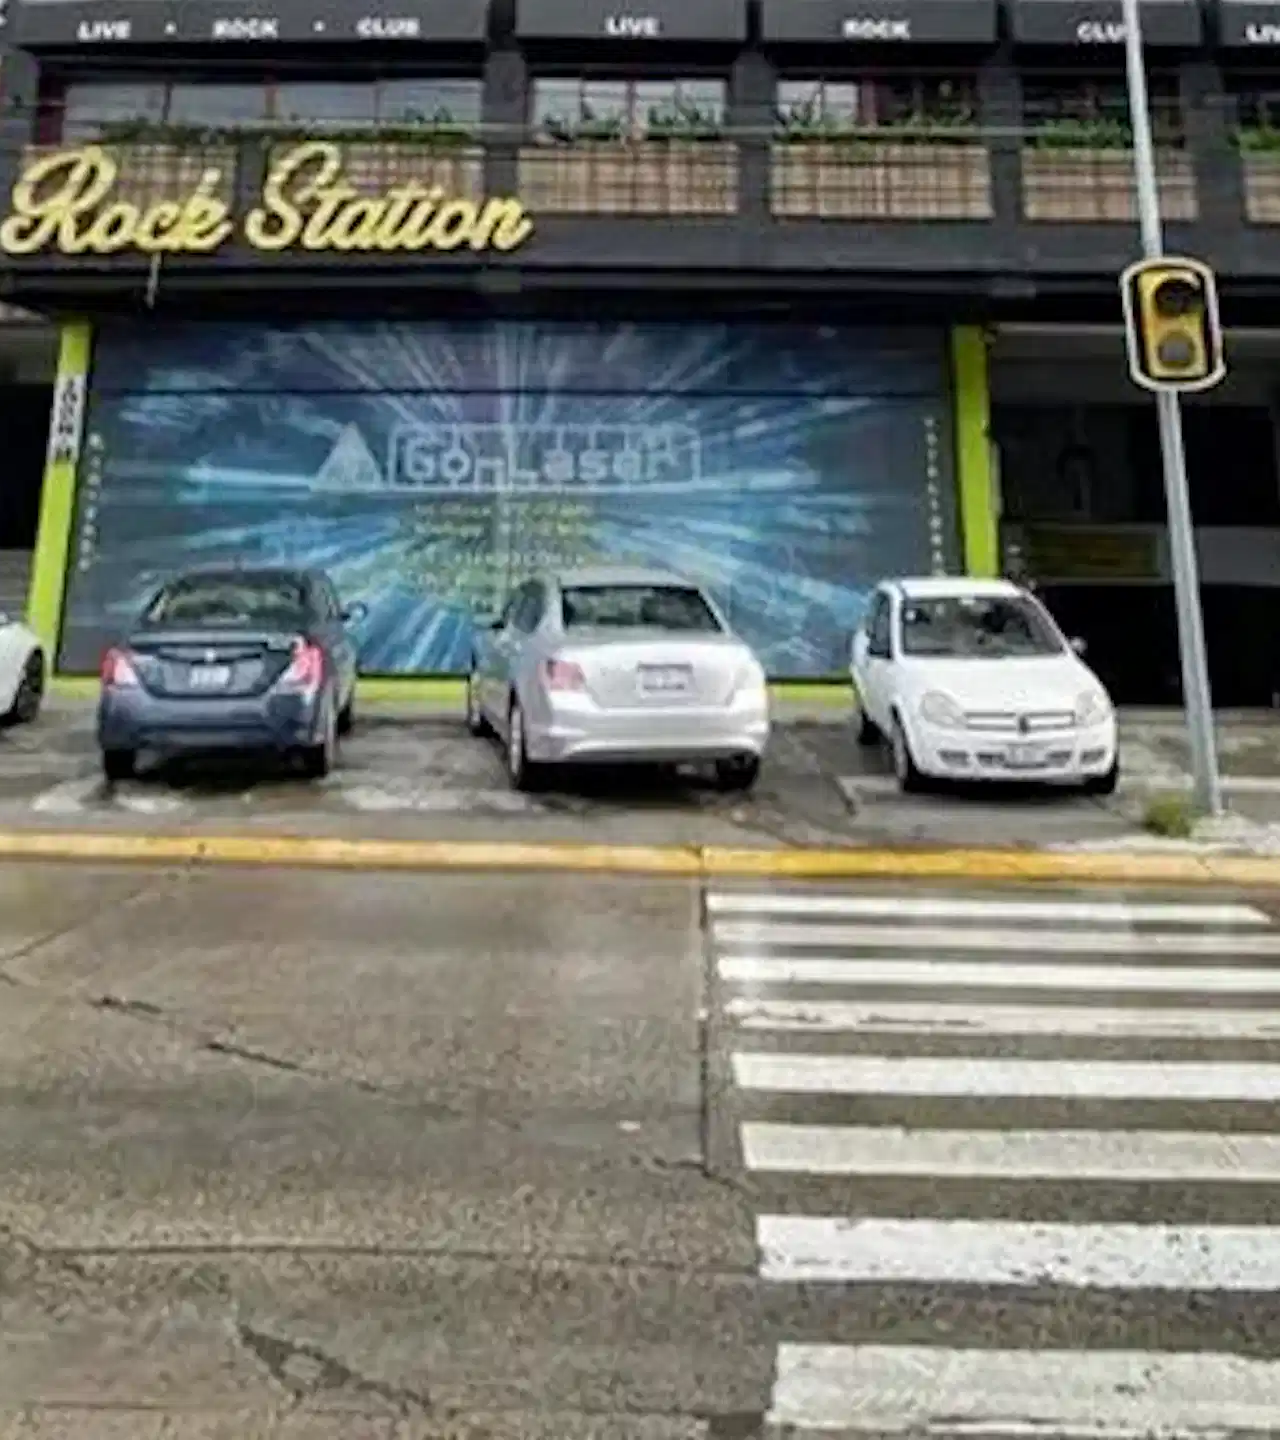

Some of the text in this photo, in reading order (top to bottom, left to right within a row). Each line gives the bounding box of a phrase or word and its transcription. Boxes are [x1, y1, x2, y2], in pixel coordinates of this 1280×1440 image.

[77, 18, 420, 40] LIVE ROCK CLUB
[606, 16, 659, 37] LIVE
[842, 18, 911, 40] ROCK
[1076, 22, 1129, 43] CLU
[0, 142, 533, 254] Rock Station
